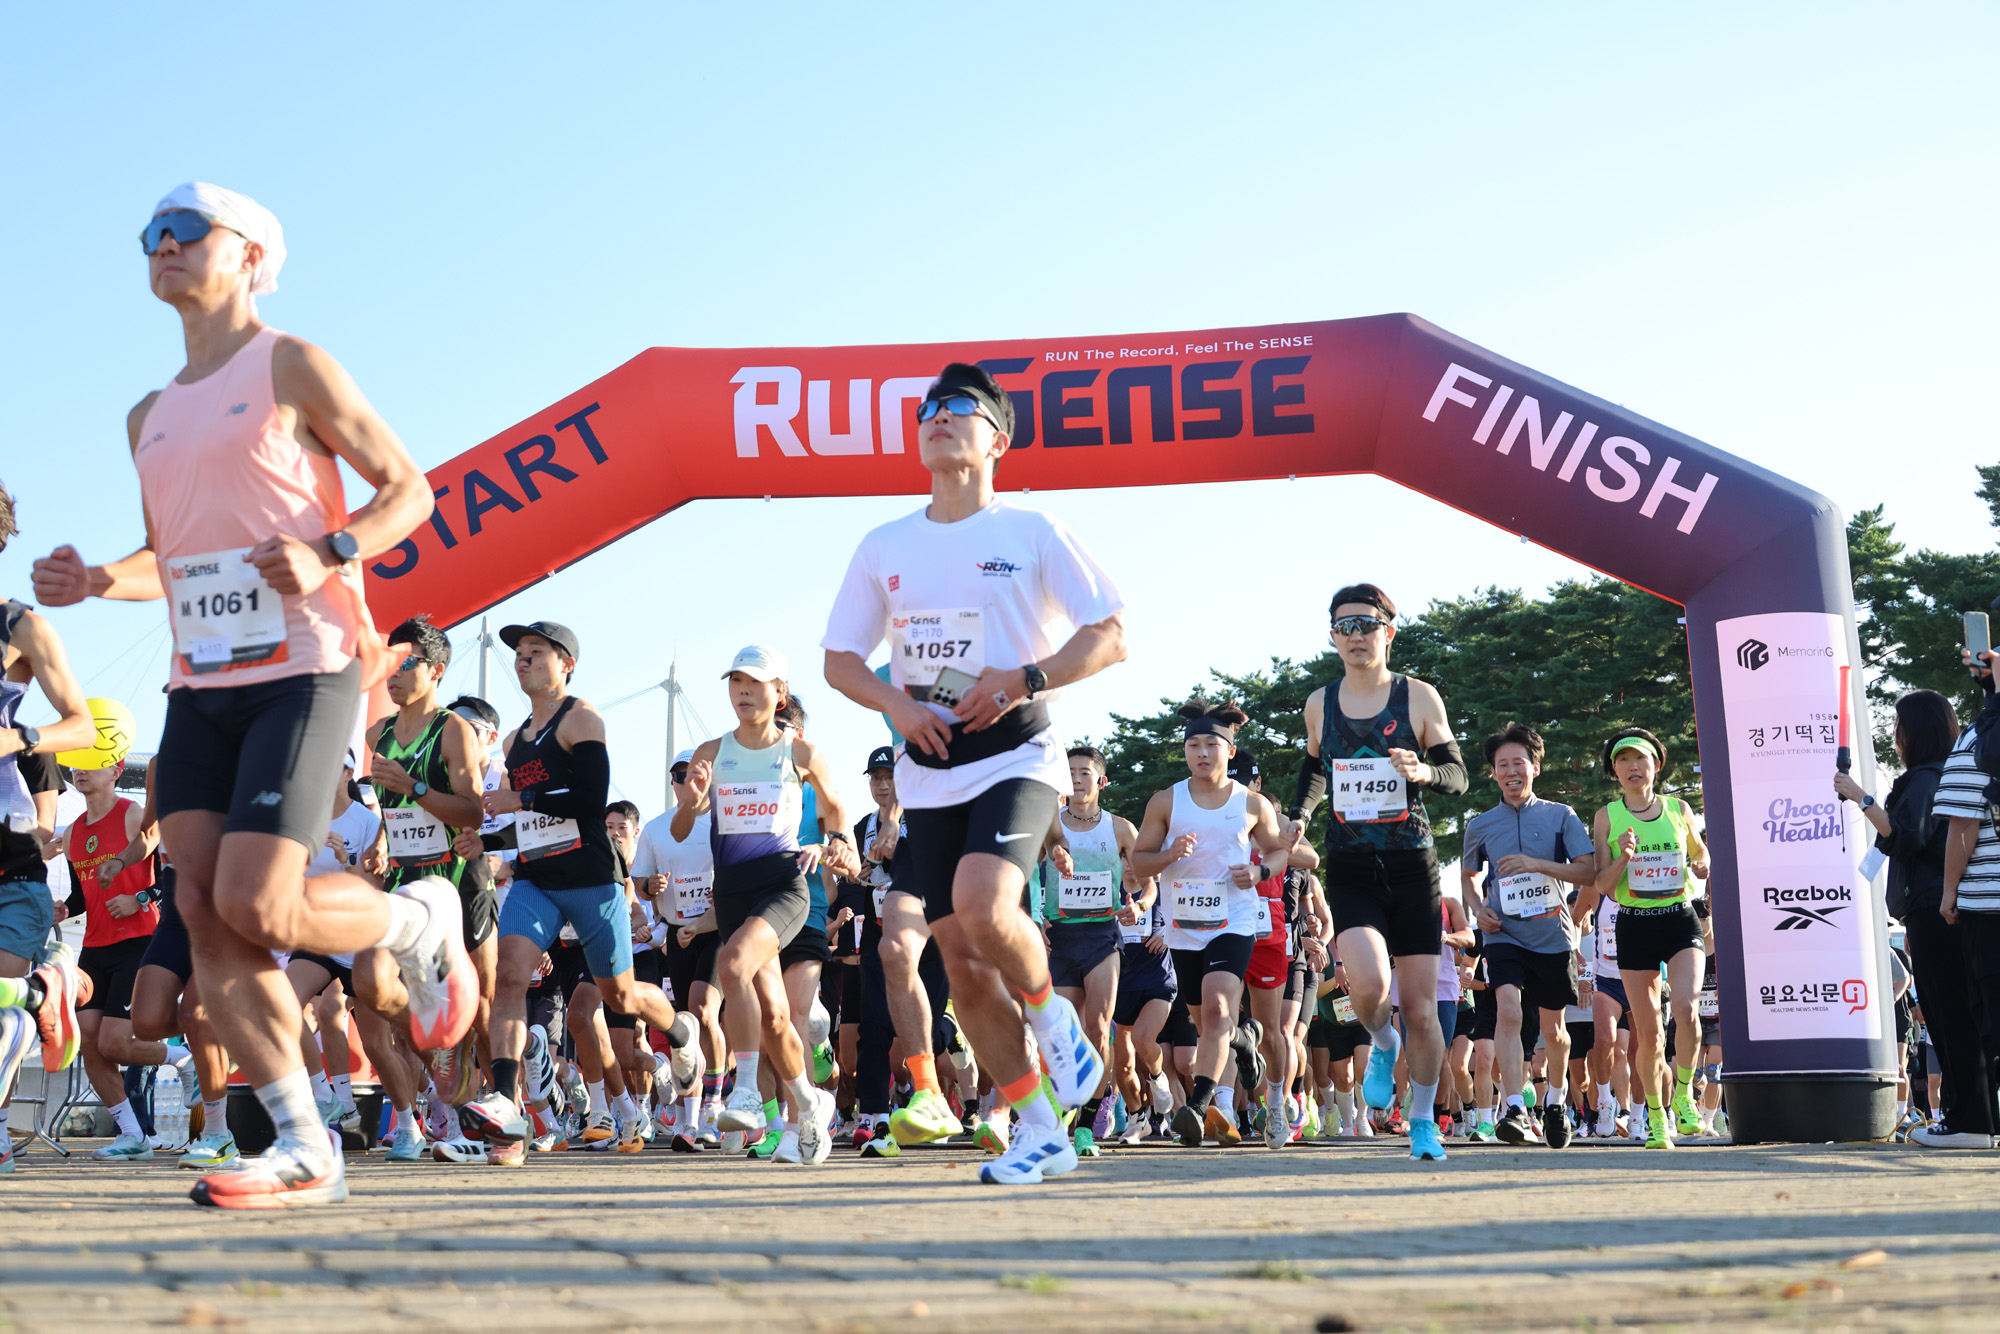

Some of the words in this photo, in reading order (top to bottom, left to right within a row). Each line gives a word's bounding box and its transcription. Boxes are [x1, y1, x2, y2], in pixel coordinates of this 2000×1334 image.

[1045, 351, 1079, 362] RUN
[1084, 348, 1114, 360] The
[1119, 345, 1179, 358] Record,
[1185, 342, 1218, 355] Feel
[1223, 340, 1254, 352] The
[1259, 335, 1313, 349] SENSE
[1422, 362, 1720, 535] FINISH
[181, 600, 192, 617] M
[197, 588, 259, 618] 1061
[912, 627, 943, 638] B-170
[904, 644, 913, 657] M
[916, 640, 972, 659] 1057
[1777, 646, 1834, 658] MemorinG
[1809, 713, 1833, 721] 1958
[1750, 749, 1785, 758] KYUNGGI
[1340, 782, 1350, 792] M
[1355, 780, 1398, 793] 1450
[724, 806, 733, 816] W
[737, 803, 778, 817] 2500
[1768, 798, 1836, 820] Choco
[393, 830, 399, 838] M
[402, 825, 436, 840] 1767
[522, 822, 530, 832] M
[1762, 815, 1843, 843] Health
[1646, 867, 1678, 877] 2176
[1075, 887, 1107, 897] 1772
[1507, 893, 1516, 901] M
[1519, 885, 1551, 900] 1056
[1763, 885, 1852, 906] Reebok
[1178, 897, 1186, 905] M
[1189, 896, 1221, 907] 1538
[1634, 904, 1679, 916] DESCENTE
[1759, 983, 1840, 1005] 일요신문
